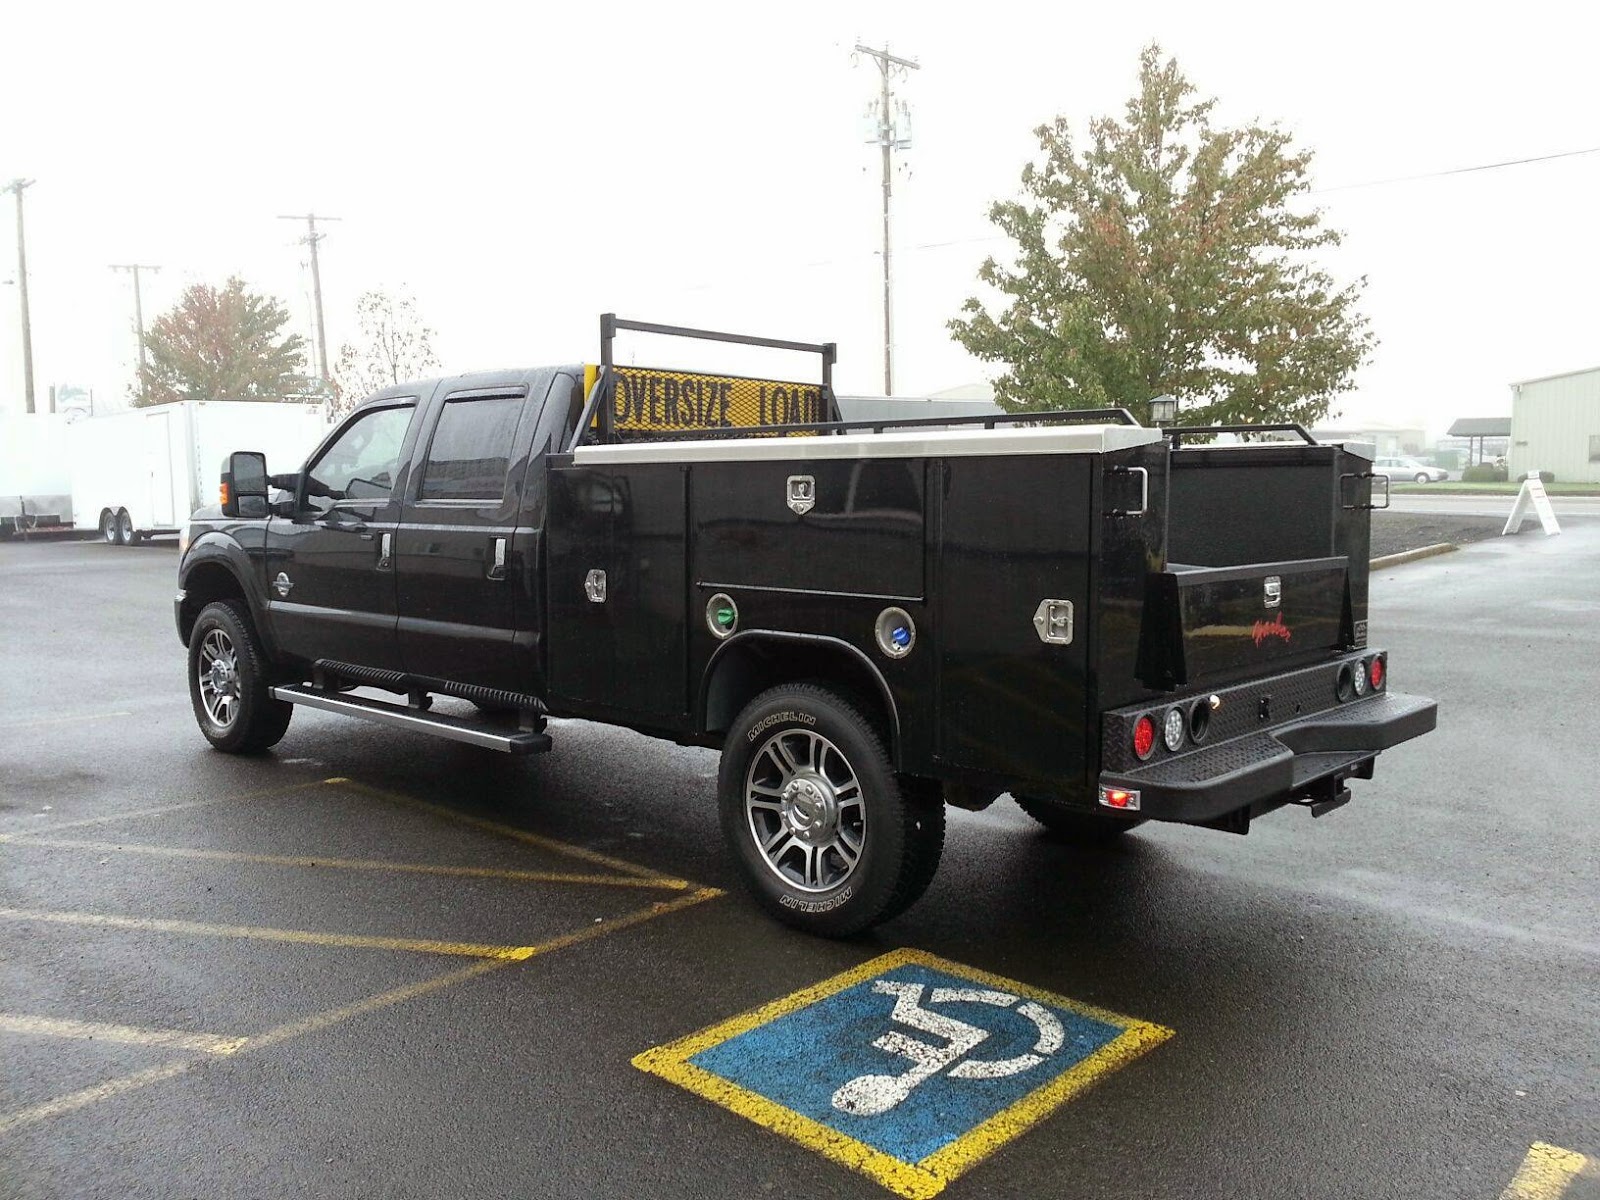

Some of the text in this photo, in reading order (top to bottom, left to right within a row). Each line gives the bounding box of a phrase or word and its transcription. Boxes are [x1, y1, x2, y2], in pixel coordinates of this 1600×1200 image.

[613, 374, 818, 427] OVERSIZE LOAD
[748, 711, 816, 742] MICHELIN
[780, 886, 852, 912] MICHELIN
